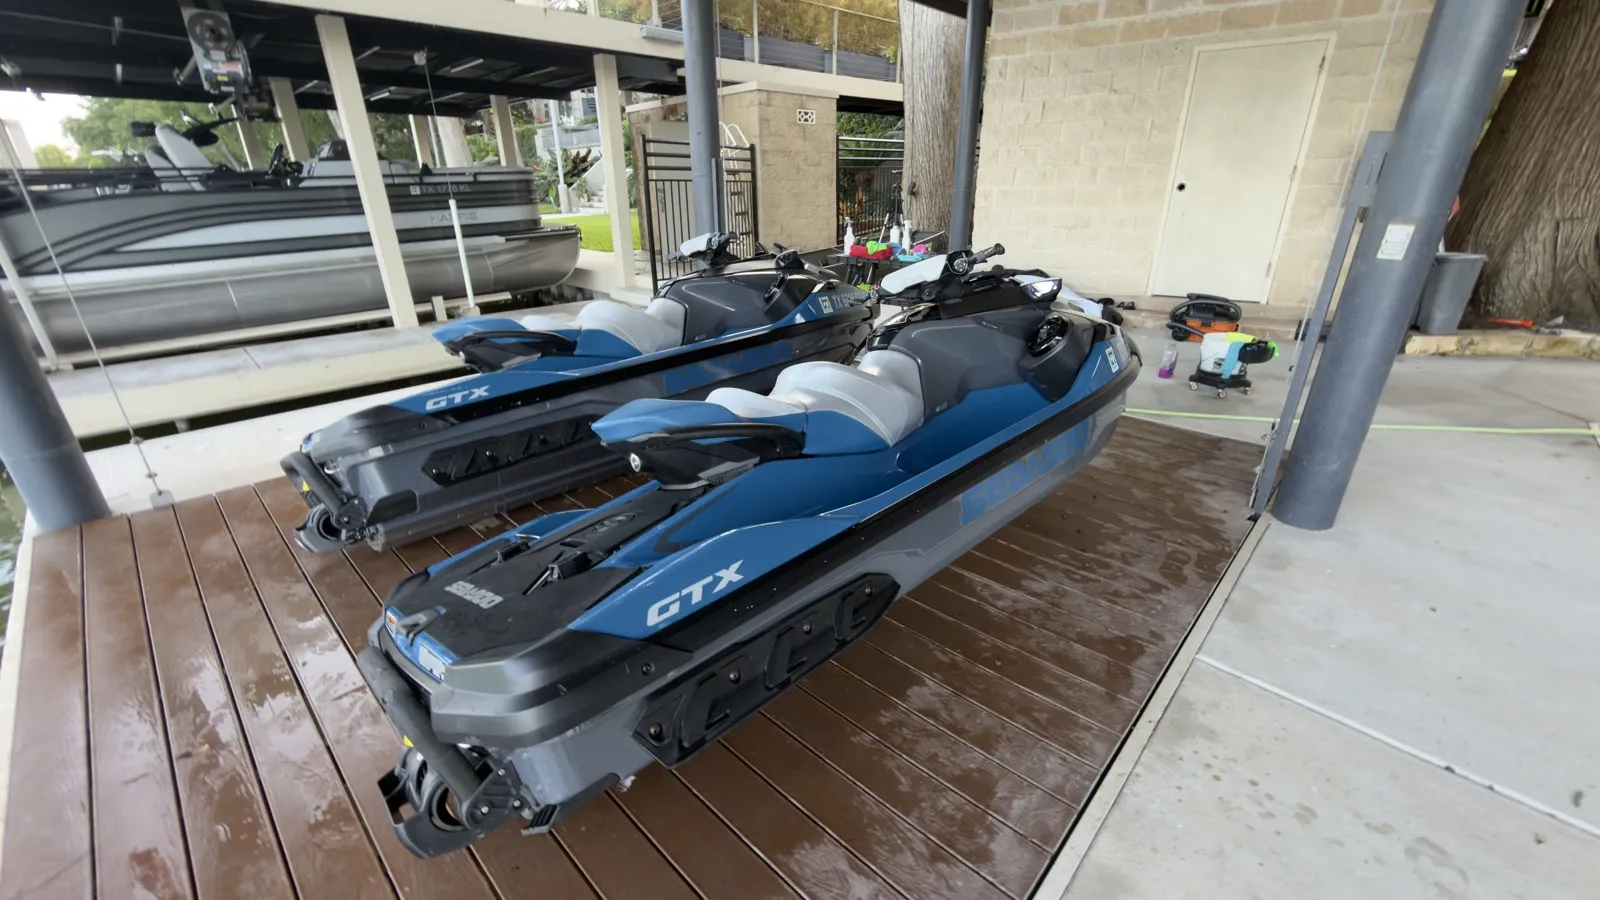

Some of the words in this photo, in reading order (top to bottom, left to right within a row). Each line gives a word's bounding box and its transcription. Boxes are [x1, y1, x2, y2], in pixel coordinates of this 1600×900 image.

[421, 184, 435, 194] TX
[428, 211, 479, 224] HARIS
[425, 385, 491, 411] GTX
[646, 559, 745, 627] GTX
